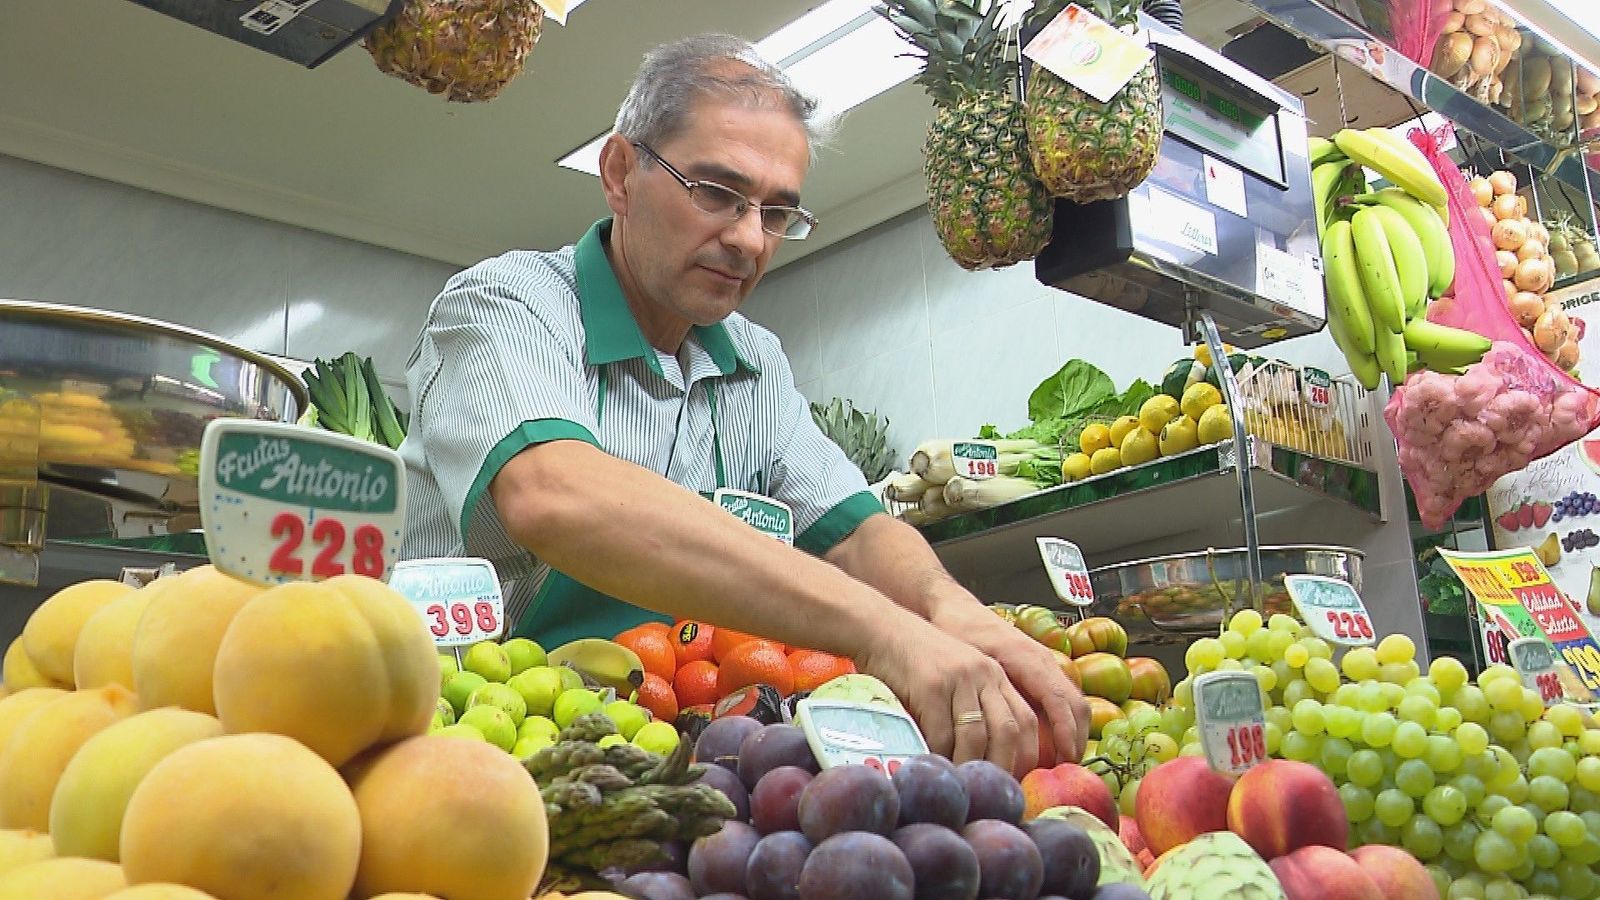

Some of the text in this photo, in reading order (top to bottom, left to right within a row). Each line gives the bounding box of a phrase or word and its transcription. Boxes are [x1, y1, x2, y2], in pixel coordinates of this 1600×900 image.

[217, 437, 290, 484] Frutas
[967, 460, 996, 475] 198
[260, 452, 389, 505] Antonio
[742, 507, 787, 532] Antonio
[268, 511, 385, 580] 228
[1520, 590, 1563, 614] Calidad
[426, 601, 497, 637] 398
[1537, 612, 1579, 635] Selecta
